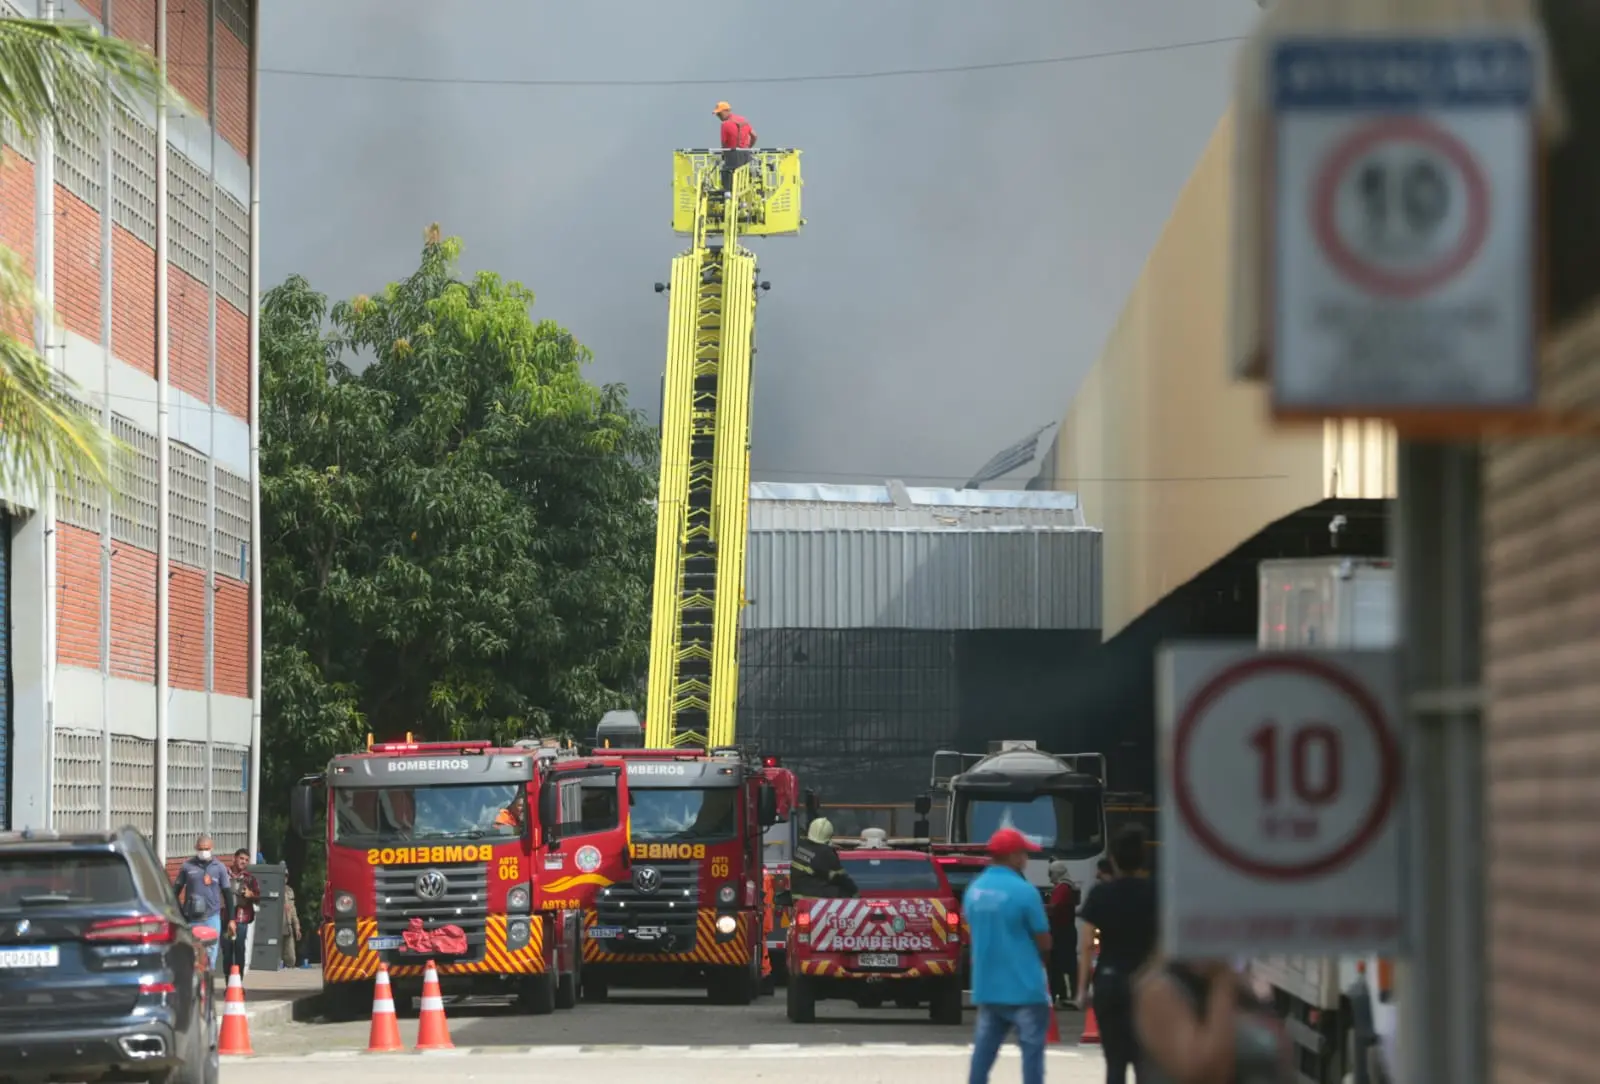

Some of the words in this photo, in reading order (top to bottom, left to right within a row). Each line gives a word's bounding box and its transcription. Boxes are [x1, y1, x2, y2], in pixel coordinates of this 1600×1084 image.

[1356, 159, 1452, 236] 10
[387, 759, 469, 772] BOMBEIROS
[627, 765, 684, 775] MBEIROS
[1249, 722, 1342, 806] 10
[499, 856, 518, 865] ABTS
[499, 865, 519, 880] 06
[711, 864, 729, 877] 09
[833, 936, 932, 948] BOMBEIROS
[0, 952, 51, 965] CQ6D63
